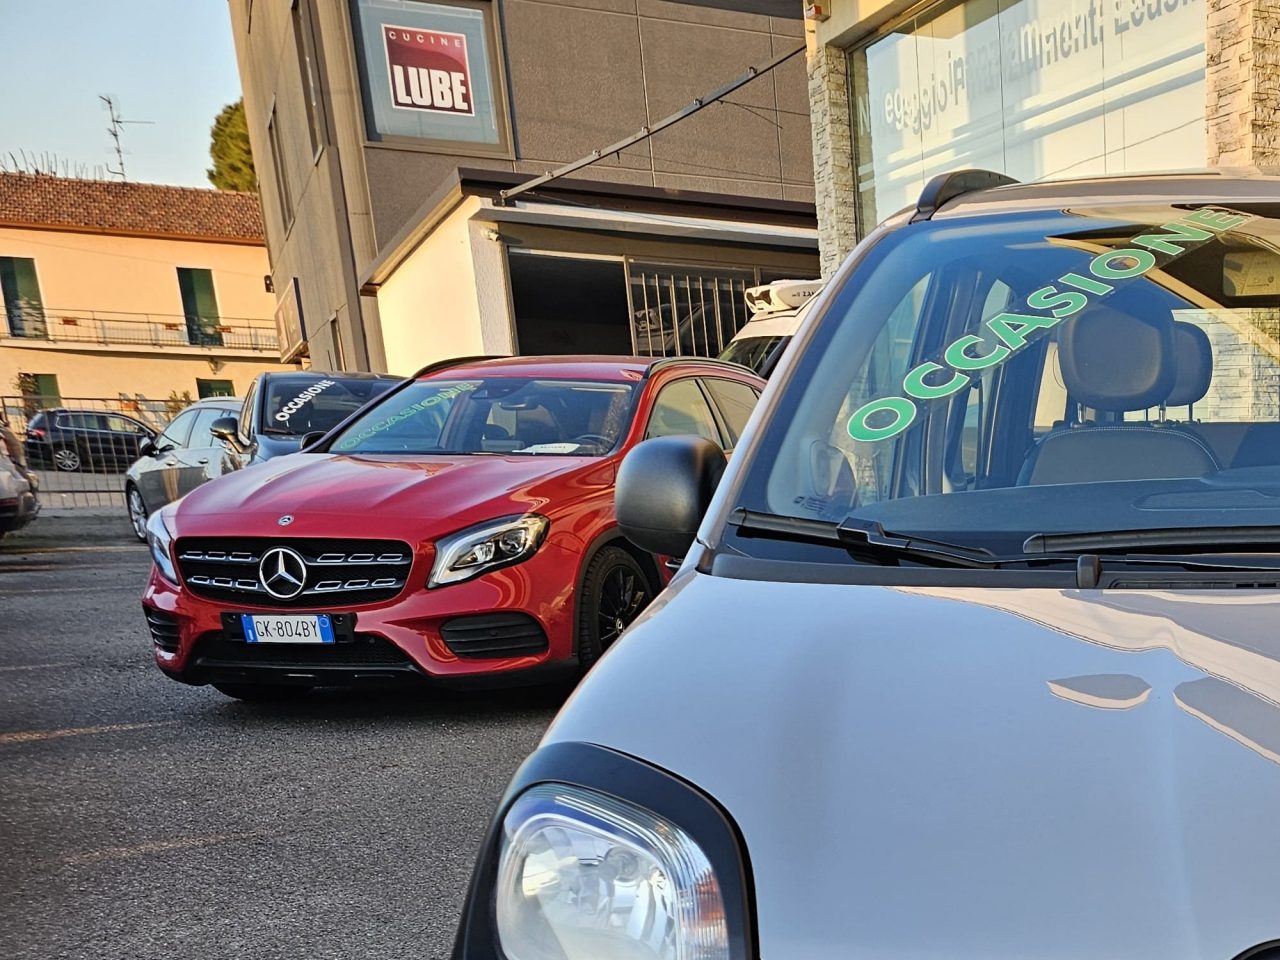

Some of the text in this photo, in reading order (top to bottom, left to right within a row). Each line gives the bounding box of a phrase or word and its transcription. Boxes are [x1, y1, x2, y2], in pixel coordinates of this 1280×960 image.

[388, 31, 462, 48] CUCINE
[392, 64, 469, 110] LUBE
[847, 206, 1250, 442] OCCASIONE
[275, 379, 336, 422] OCCASIONE
[341, 381, 478, 450] OCCASIONE
